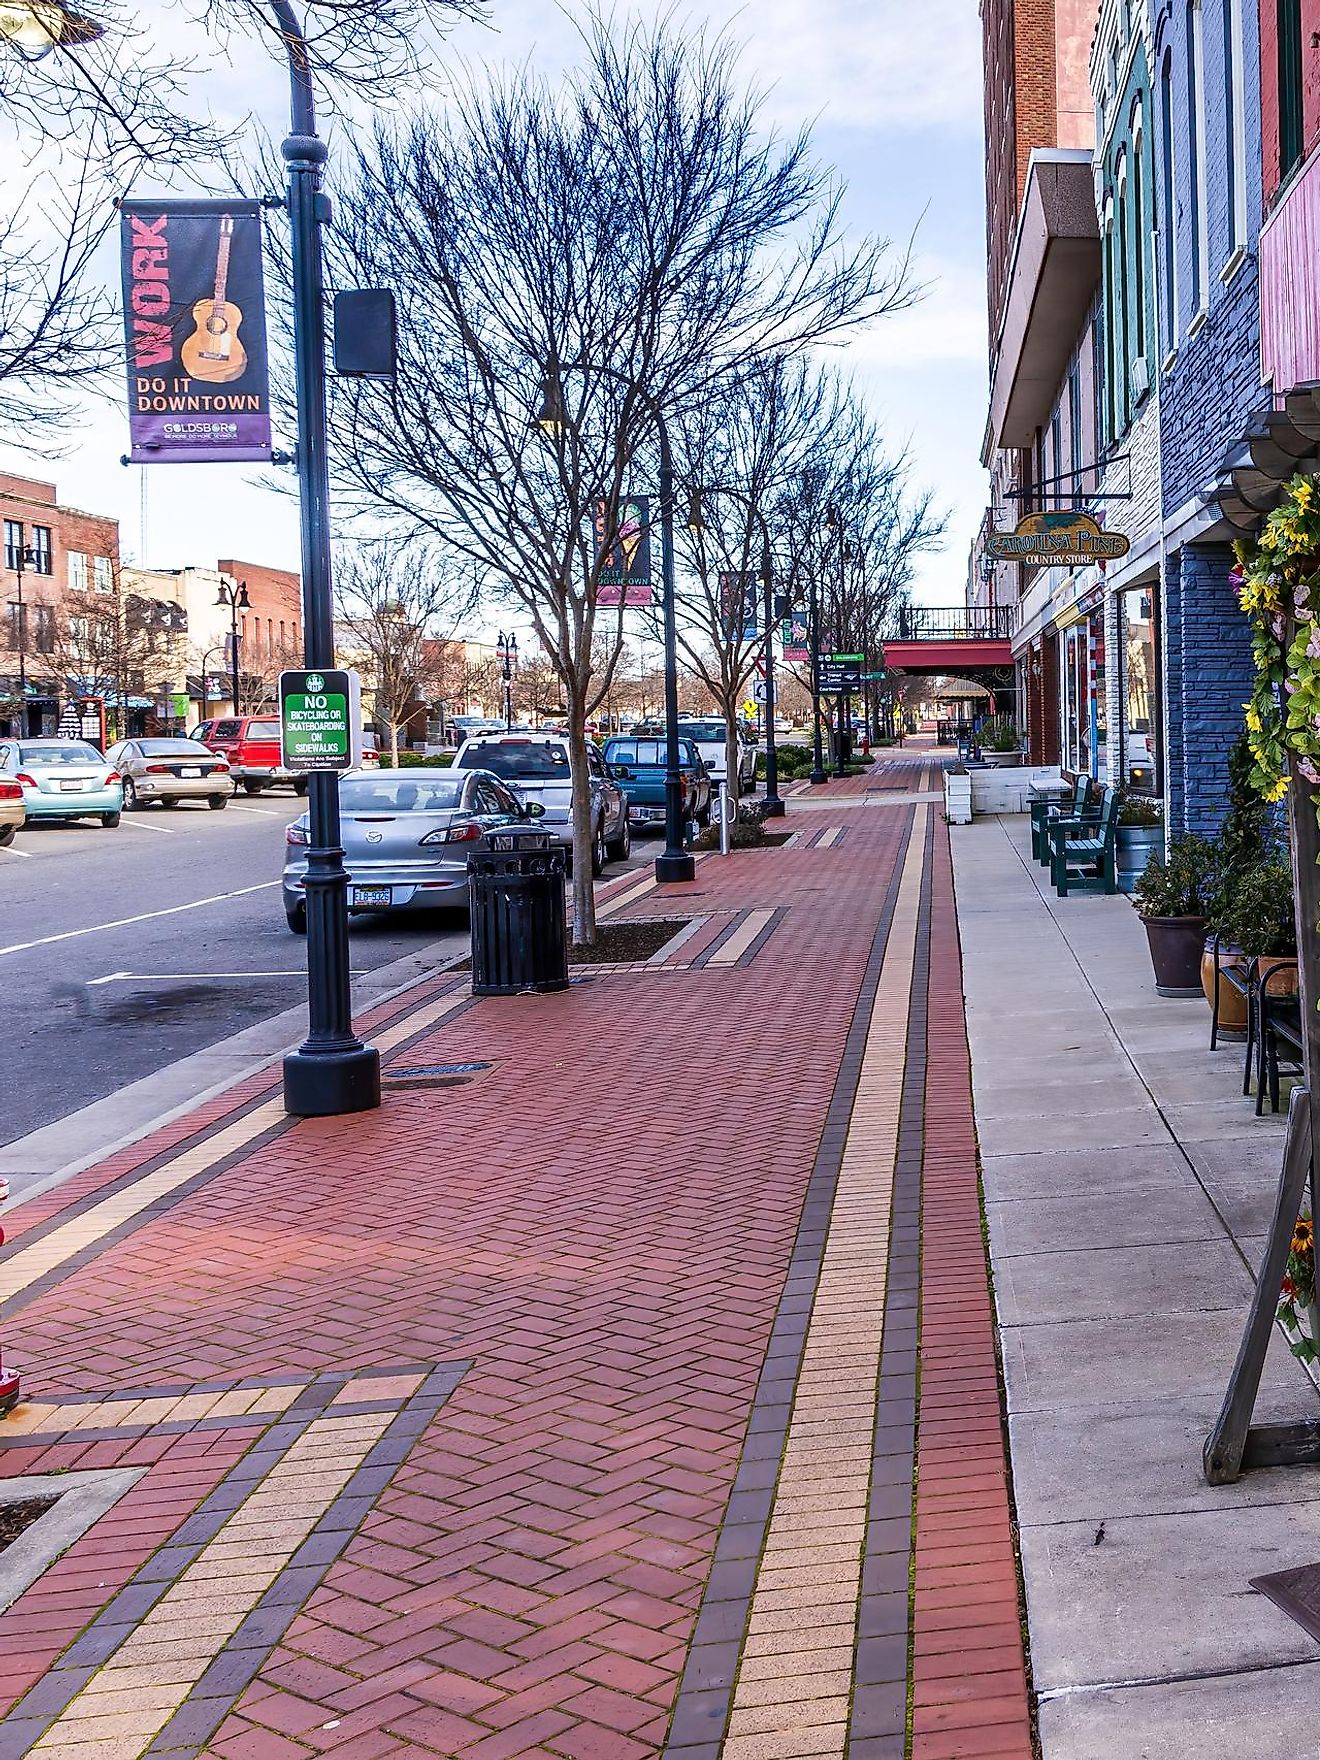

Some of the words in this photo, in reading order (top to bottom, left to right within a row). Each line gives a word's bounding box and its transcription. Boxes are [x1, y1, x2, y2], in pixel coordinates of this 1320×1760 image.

[131, 214, 173, 369] WORK
[137, 377, 166, 393] DO
[174, 378, 192, 393] IT
[138, 395, 260, 411] DOWNTOWN
[163, 423, 237, 433] GOLDSBORO
[988, 532, 1073, 554] CAROLINA
[1026, 554, 1065, 565] COUNTRY
[1066, 554, 1093, 564] STORE
[305, 696, 327, 708] NO
[290, 711, 329, 720] BICYCLING
[330, 710, 341, 719] OR
[287, 722, 345, 731] SKATEBOARDING
[311, 732, 322, 741] ON
[295, 743, 338, 753] SIDEWALKS
